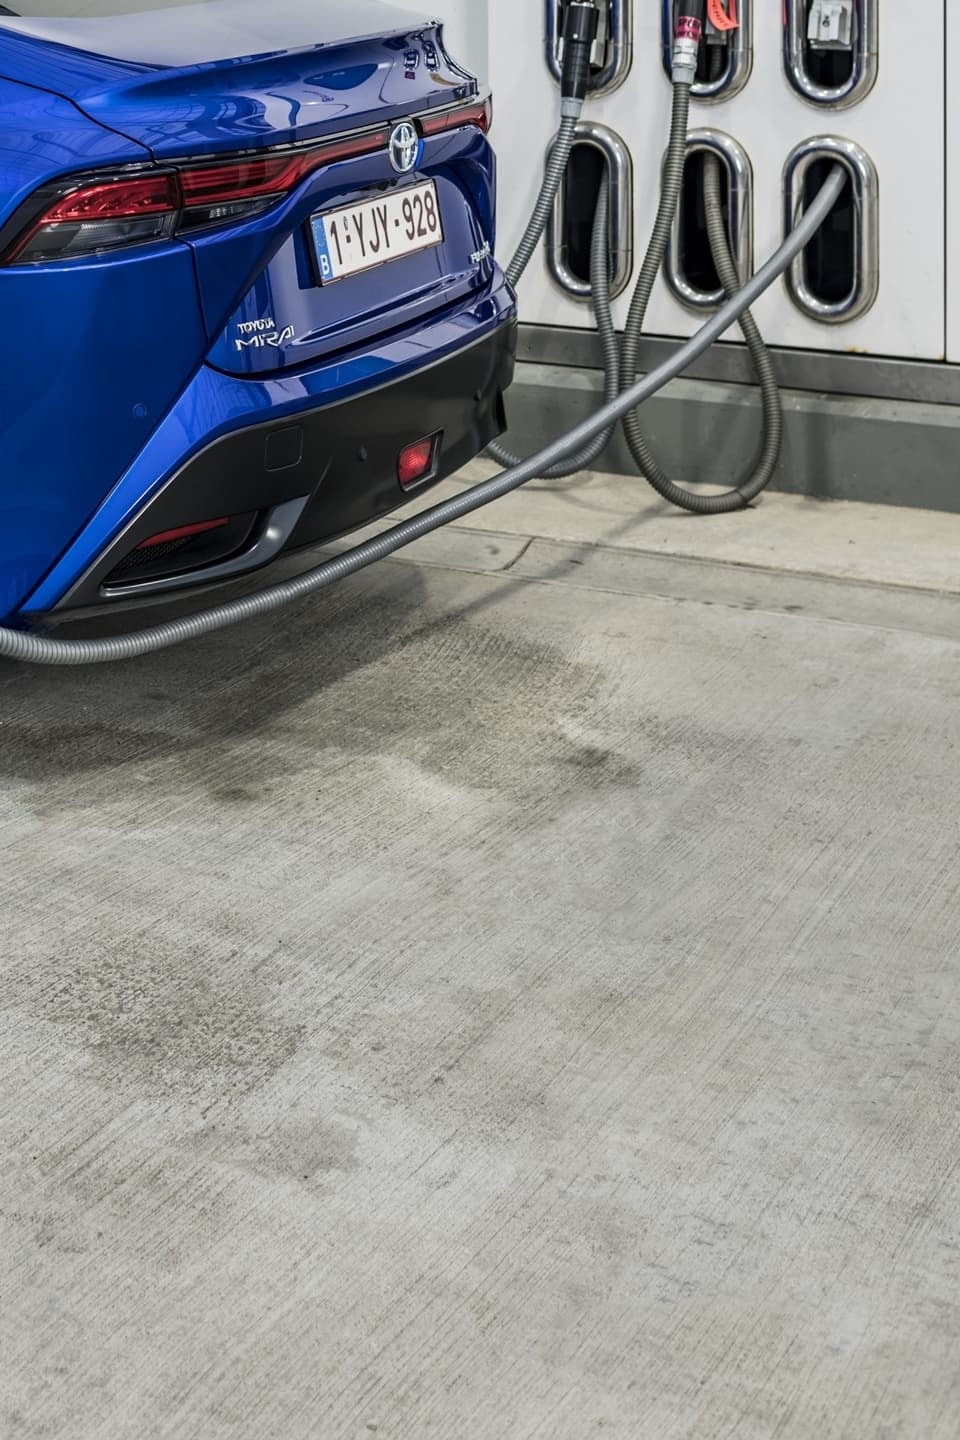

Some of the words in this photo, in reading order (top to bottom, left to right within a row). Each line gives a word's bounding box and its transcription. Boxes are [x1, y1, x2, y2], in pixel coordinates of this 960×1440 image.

[330, 190, 438, 265] 1-YJY-928
[320, 253, 331, 276] B
[236, 317, 275, 334] TOYOTA
[234, 325, 295, 351] MIRAI
